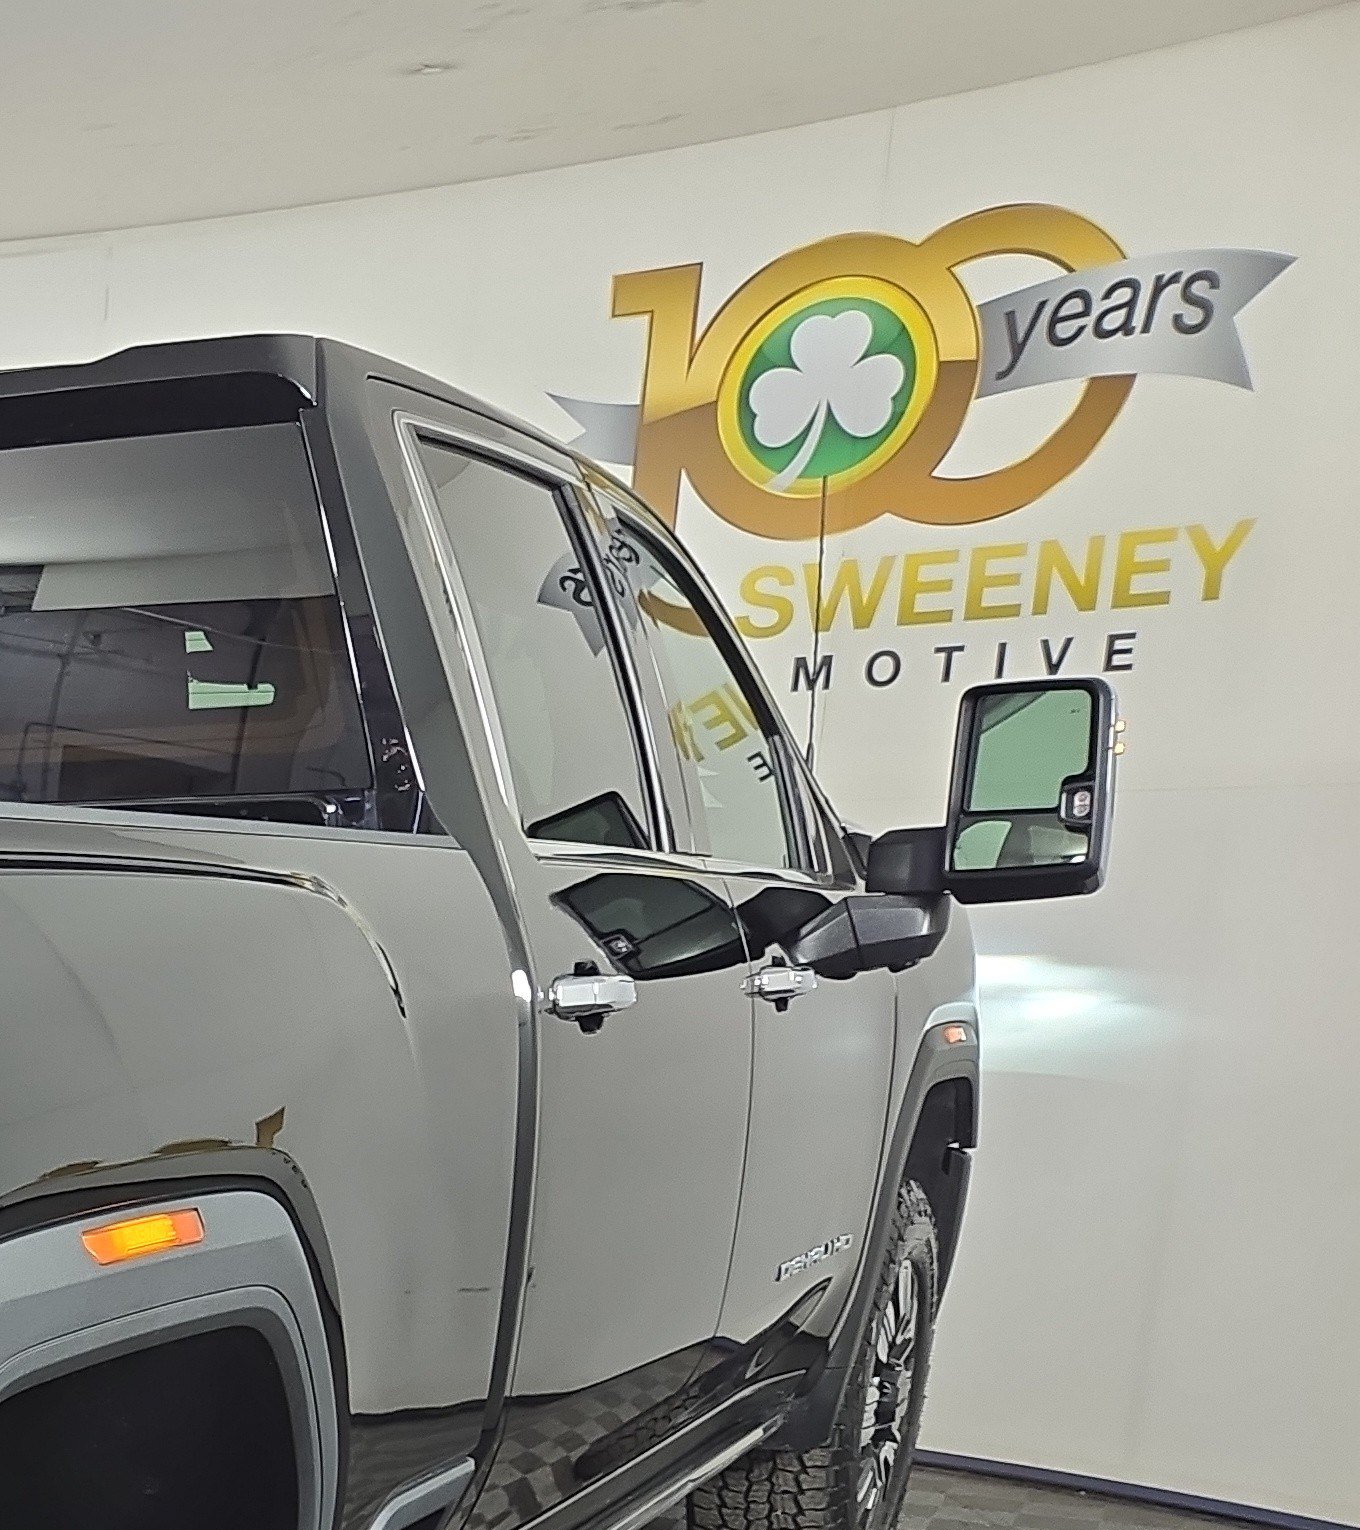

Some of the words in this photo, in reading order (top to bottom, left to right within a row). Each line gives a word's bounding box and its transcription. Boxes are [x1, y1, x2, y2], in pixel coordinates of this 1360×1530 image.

[994, 267, 1223, 381] years
[734, 518, 1259, 642] SWEENEY
[790, 631, 1139, 693] MOTIVE
